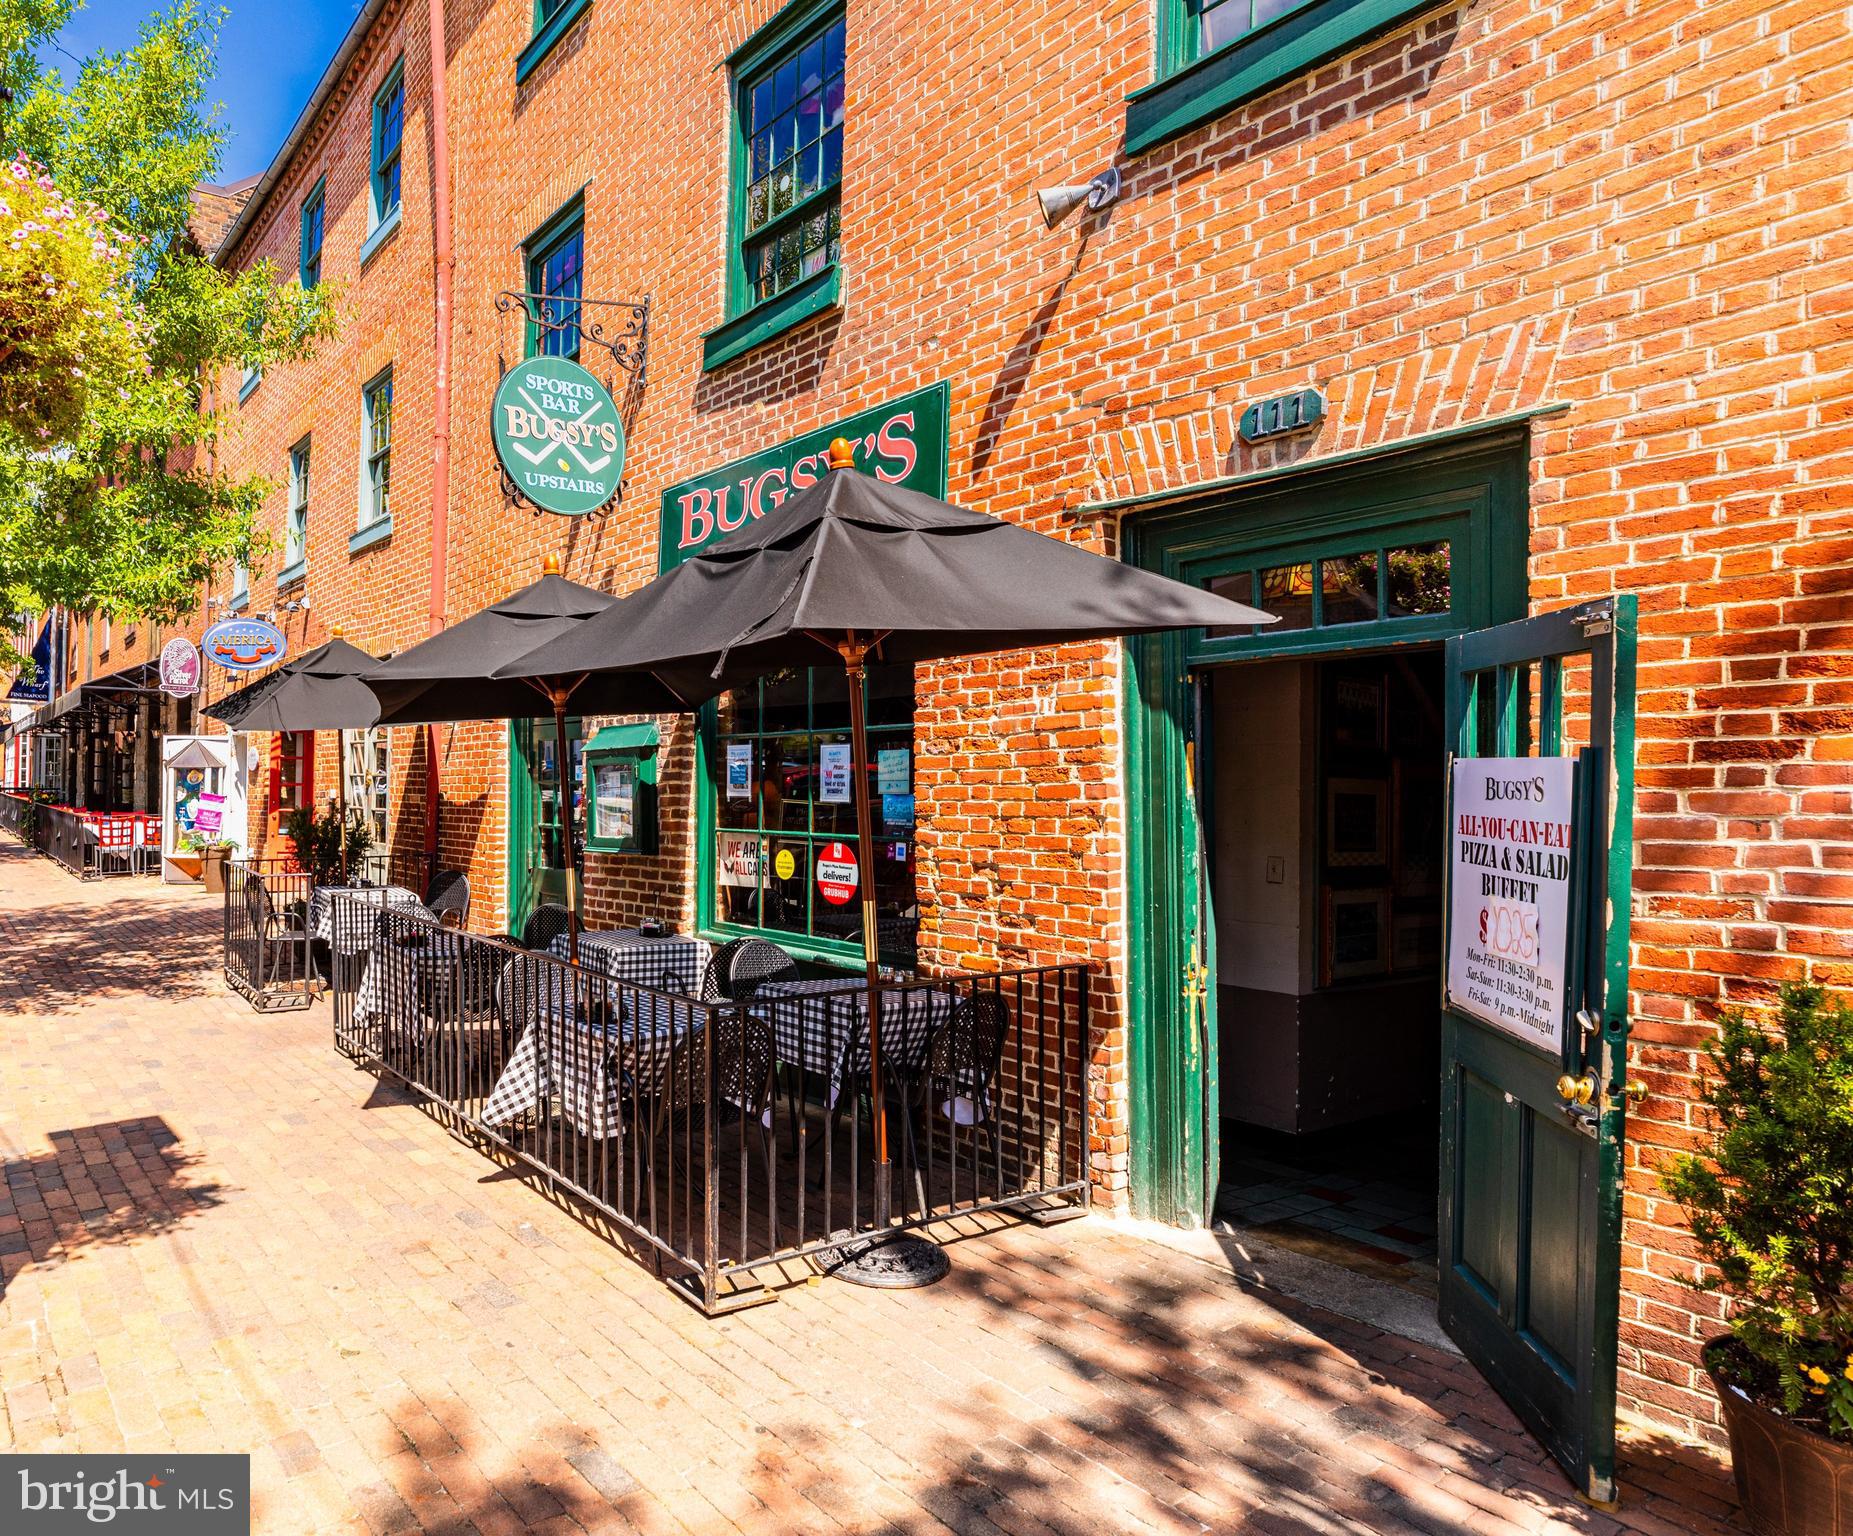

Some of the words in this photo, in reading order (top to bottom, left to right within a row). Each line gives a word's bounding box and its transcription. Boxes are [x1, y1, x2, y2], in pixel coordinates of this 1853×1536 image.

[525, 373, 594, 400] SPORTS
[541, 393, 581, 415] BAR
[1251, 392, 1310, 437] 111
[524, 472, 605, 495] UPSTAIRS
[727, 841, 742, 858] WE
[1460, 840, 1498, 869] PIZZA
[1501, 846, 1512, 871] &
[1516, 849, 1569, 881] SALAD
[735, 861, 768, 877] ALLCAS
[822, 870, 851, 882] delivers!
[823, 887, 850, 899] GRUBHUB
[1481, 873, 1539, 904] BUFFET
[1466, 947, 1496, 969] Mon-Fri:
[1497, 958, 1535, 984] 11:30-2:30
[1536, 975, 1554, 991] p.m.
[1466, 966, 1494, 988] Sat-Sun:
[1496, 978, 1534, 1003] 11:30-3:30
[1534, 995, 1552, 1012] p.m.
[1467, 986, 1492, 1007] Fri-Sat:
[1495, 998, 1500, 1010] 9
[1500, 1005, 1555, 1036] p.m.-Midnight
